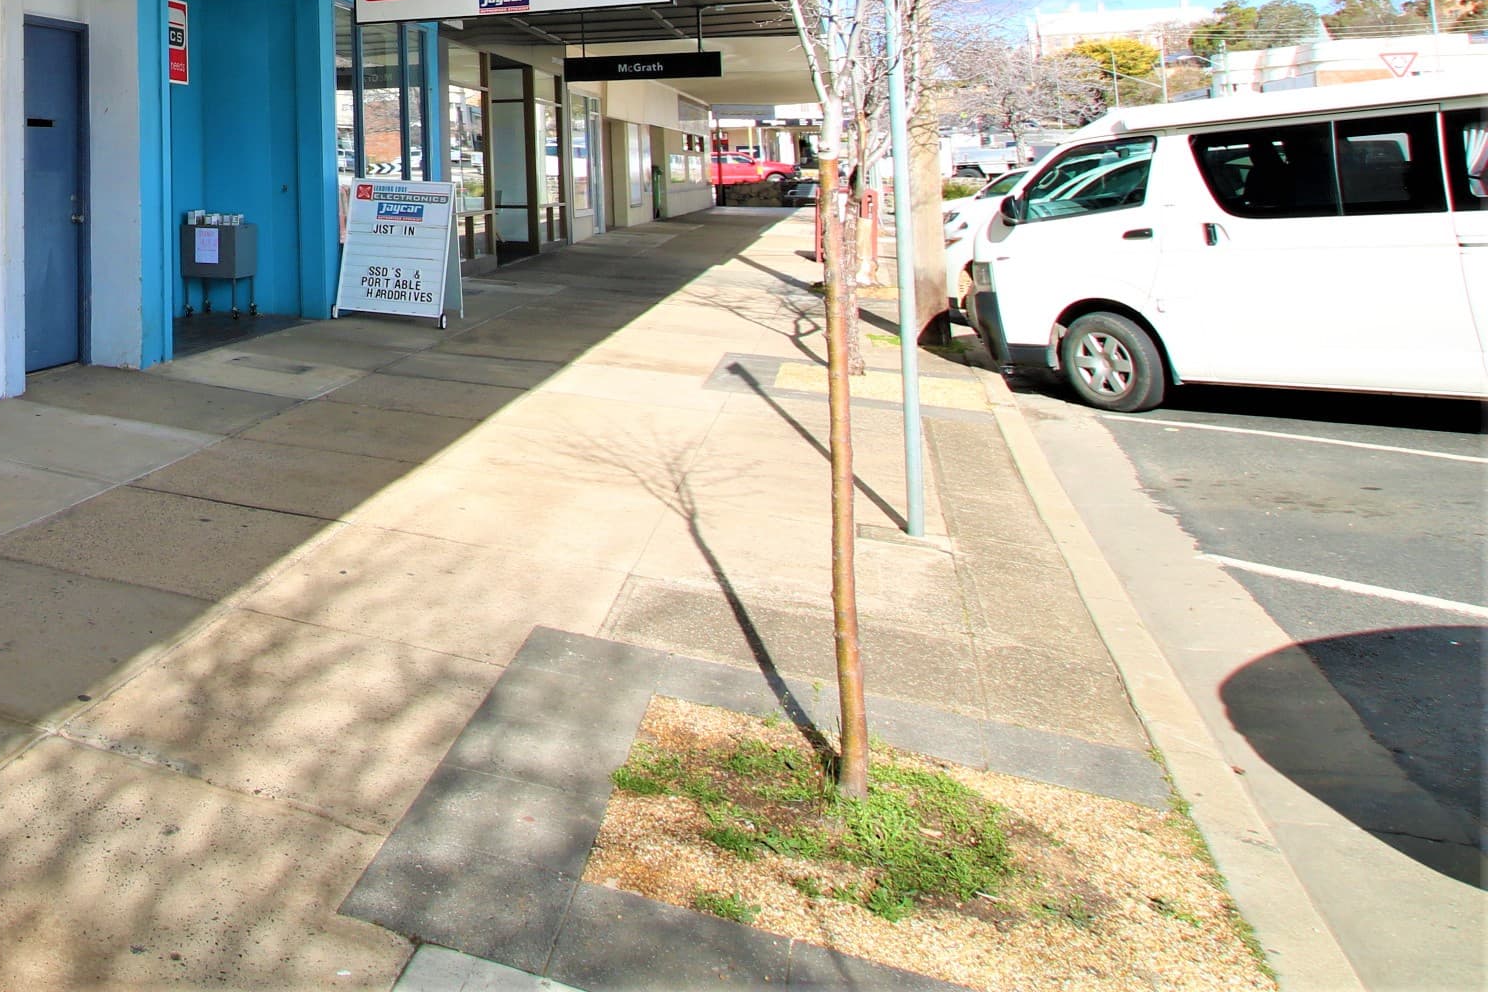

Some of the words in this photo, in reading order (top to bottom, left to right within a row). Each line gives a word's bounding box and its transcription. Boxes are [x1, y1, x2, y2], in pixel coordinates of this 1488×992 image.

[617, 61, 664, 73] McGrath
[373, 193, 447, 203] ELECTRONICS
[403, 225, 415, 236] IN
